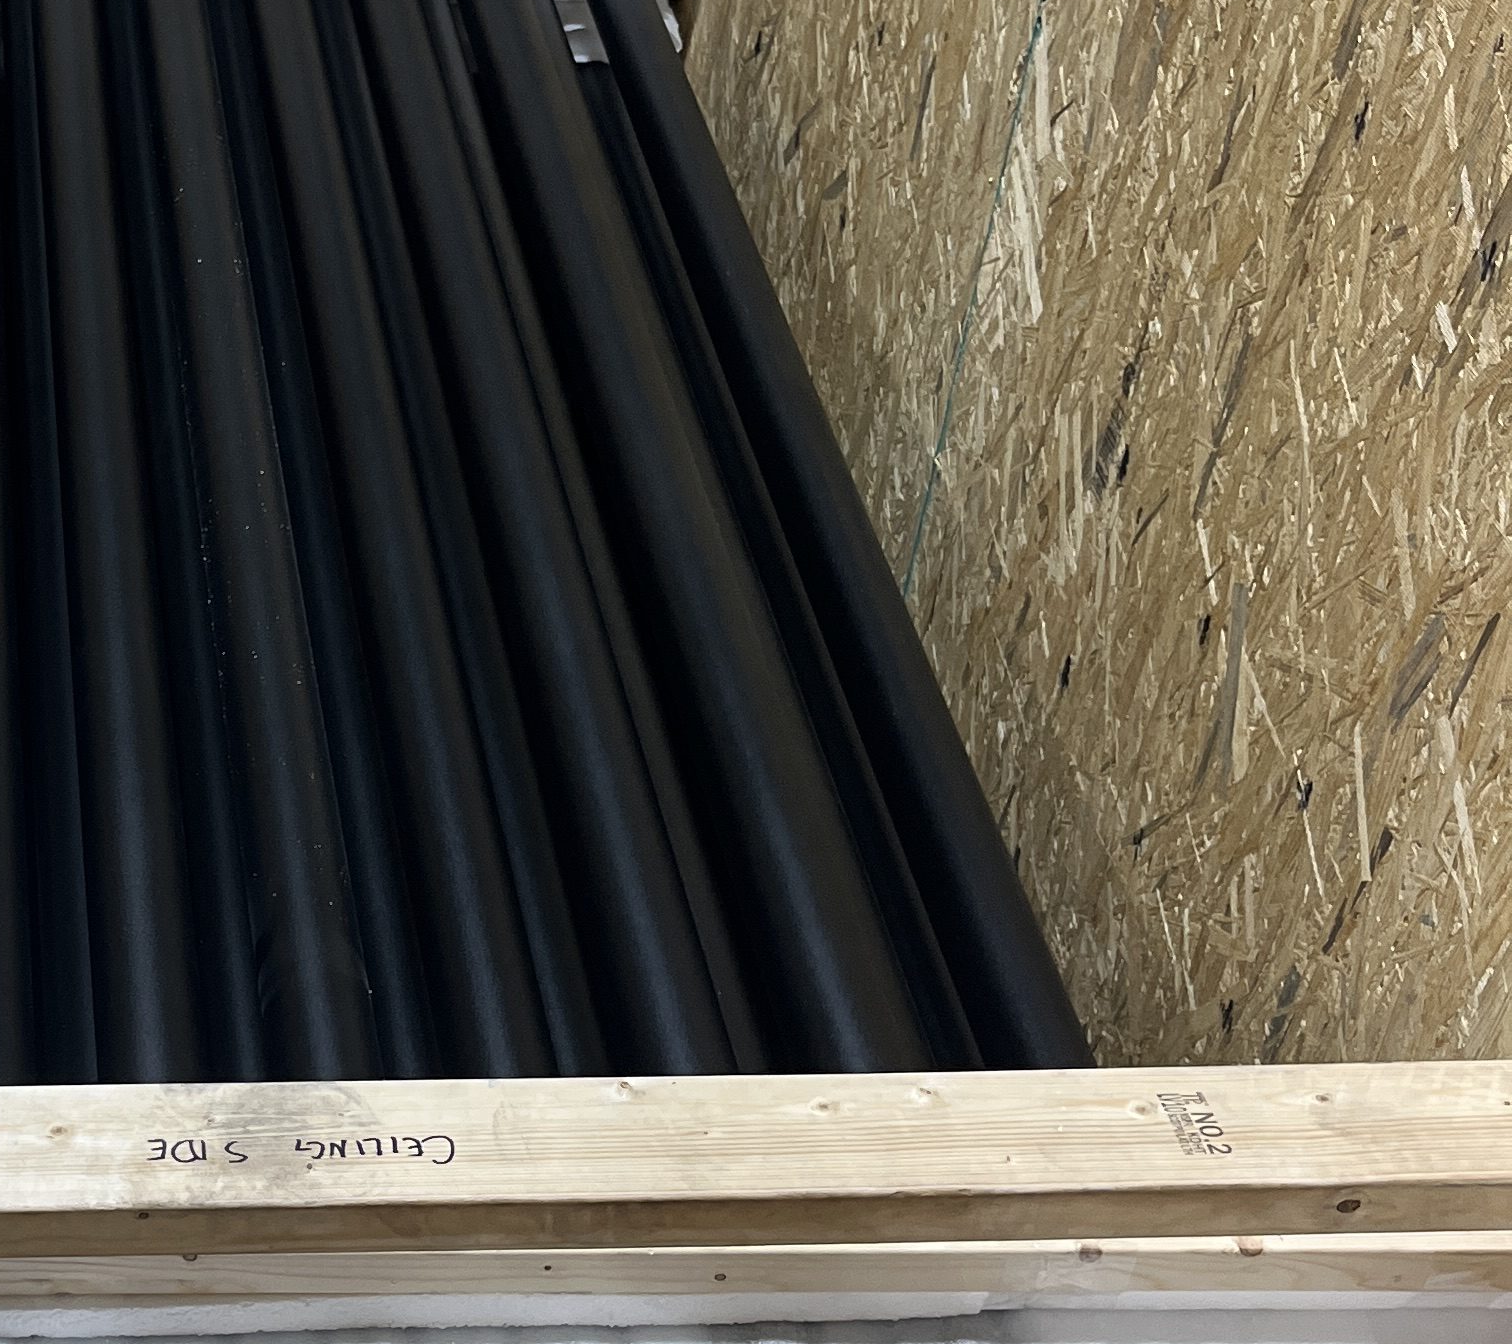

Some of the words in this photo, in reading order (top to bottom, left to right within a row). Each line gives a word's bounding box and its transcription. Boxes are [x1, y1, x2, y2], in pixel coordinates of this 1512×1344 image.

[1191, 1112, 1232, 1154] NO.2
[147, 1138, 249, 1163] SIDE
[294, 1135, 455, 1164] CEILING
